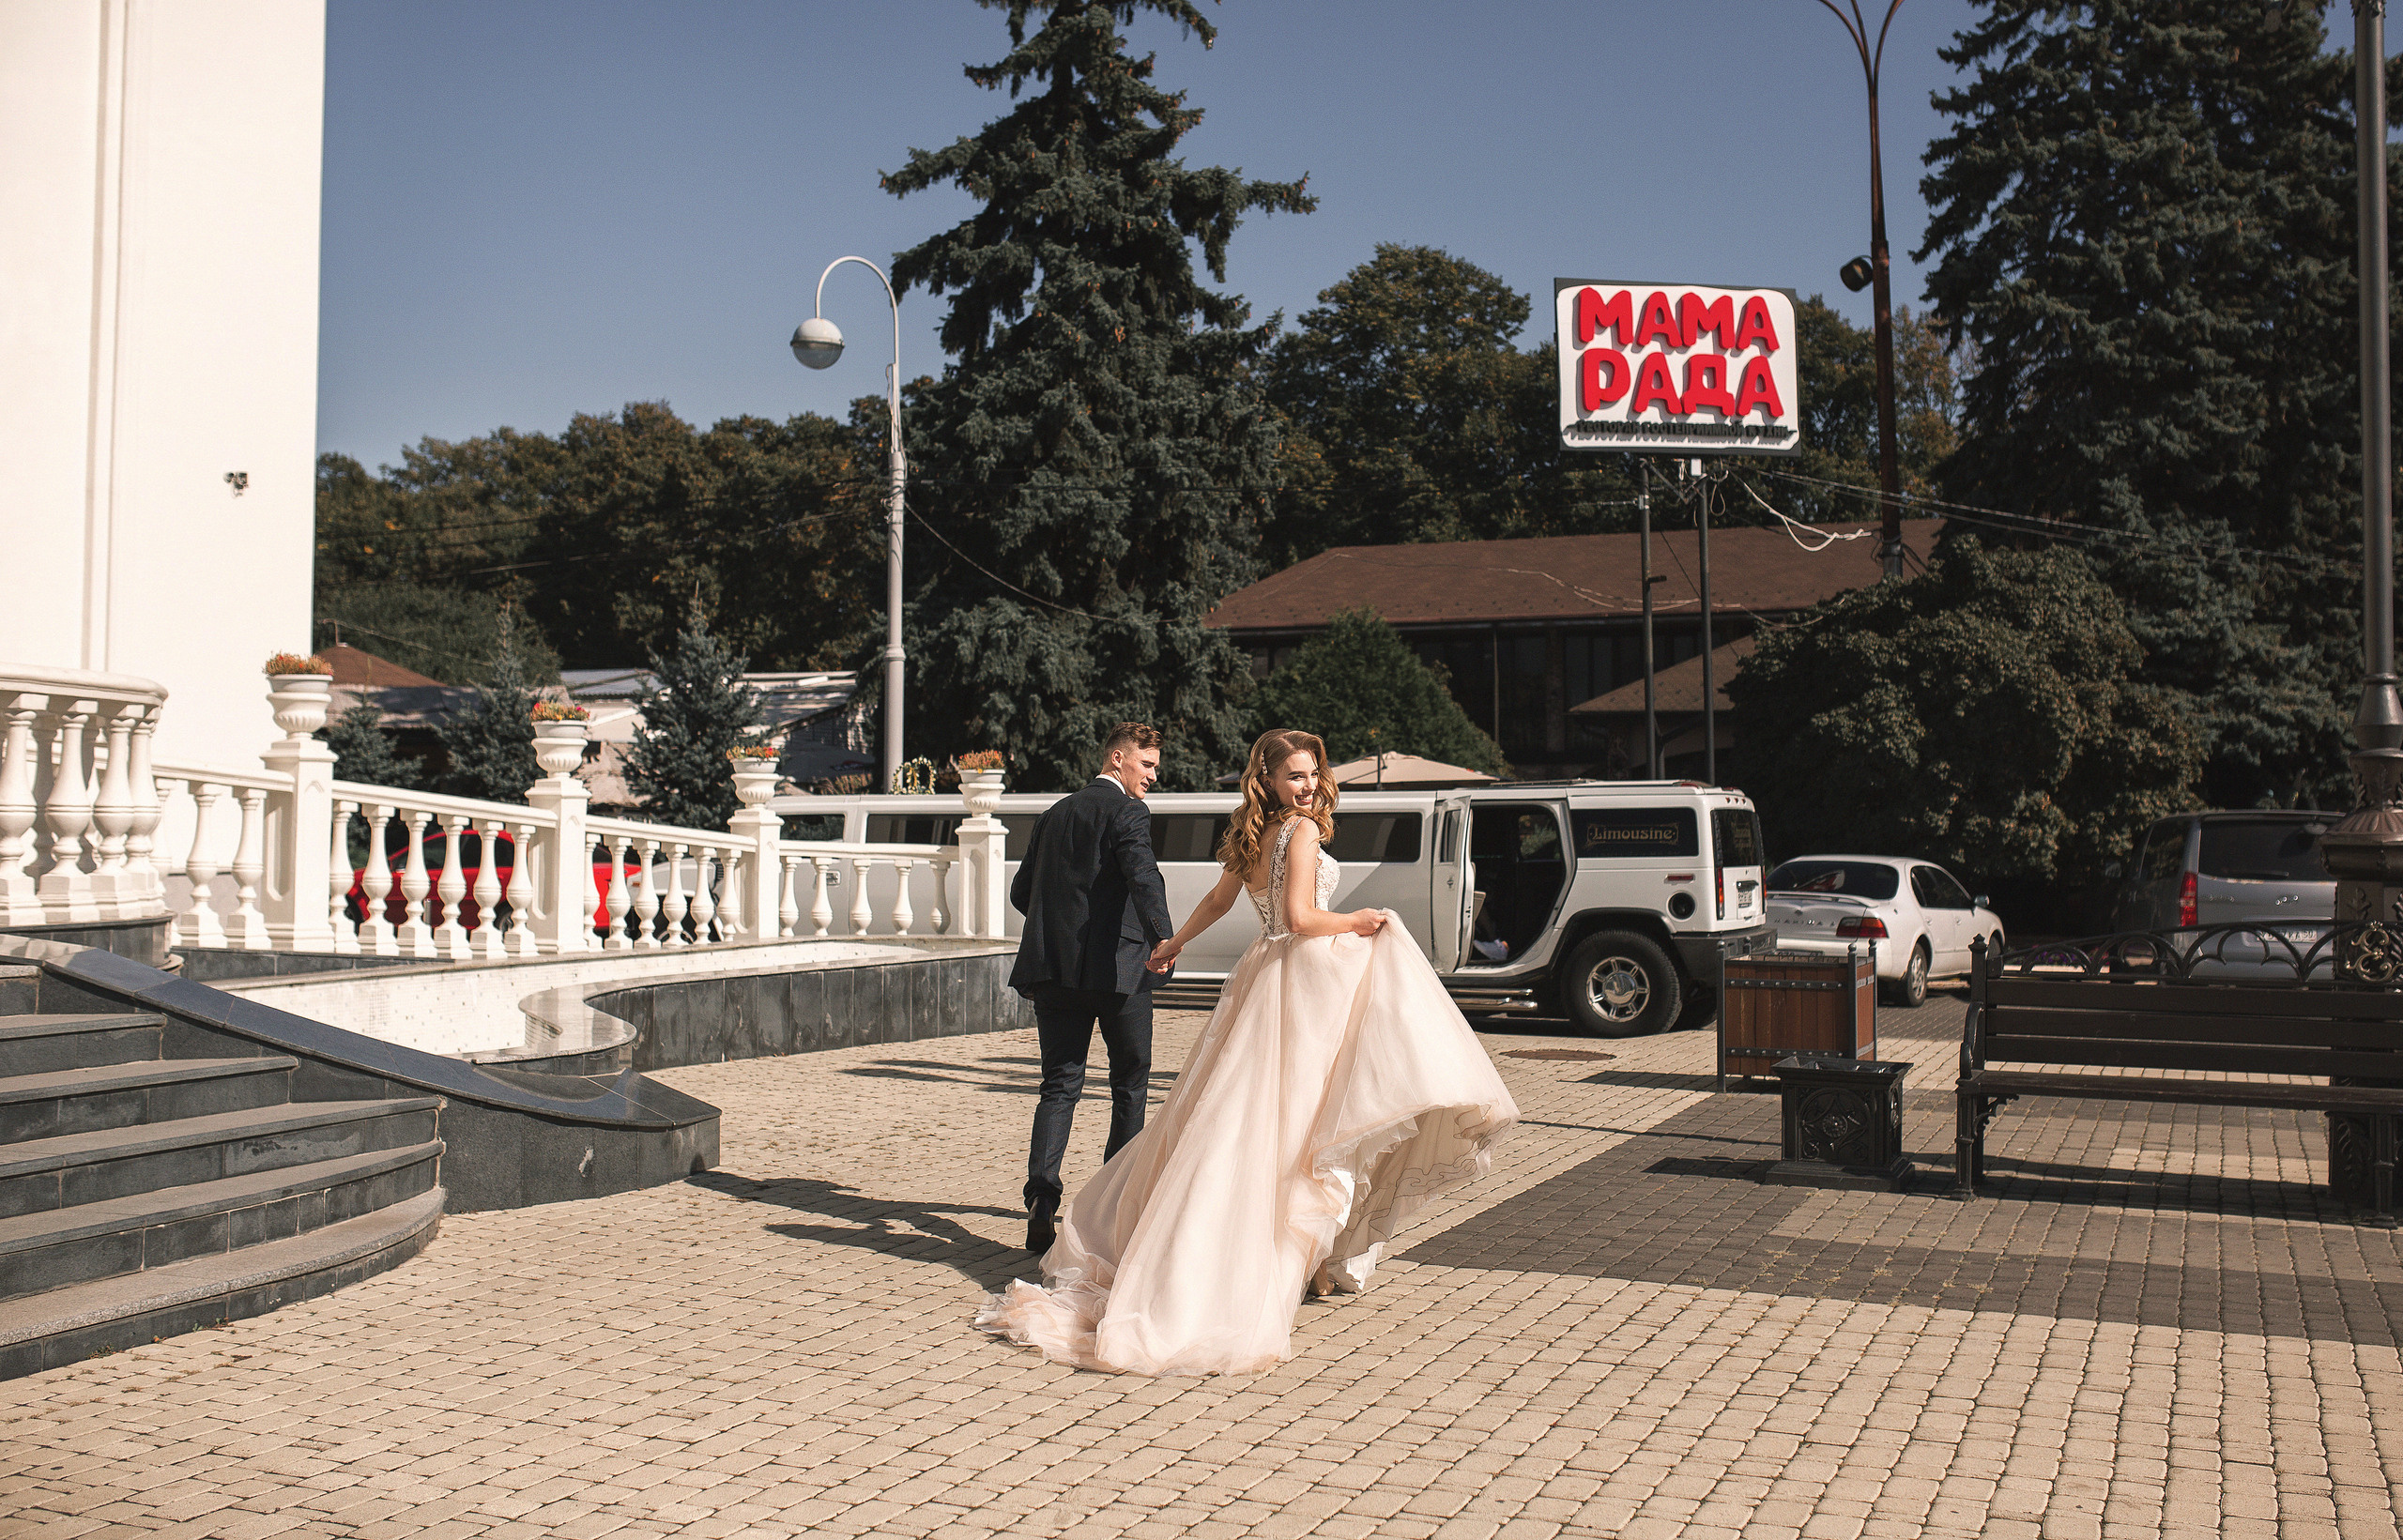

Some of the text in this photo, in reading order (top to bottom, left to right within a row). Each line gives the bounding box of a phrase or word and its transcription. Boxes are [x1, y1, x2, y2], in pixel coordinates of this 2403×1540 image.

[1579, 287, 1780, 352] МАМА
[1583, 348, 1784, 418] РАДА
[1592, 827, 1673, 841] Limousine
